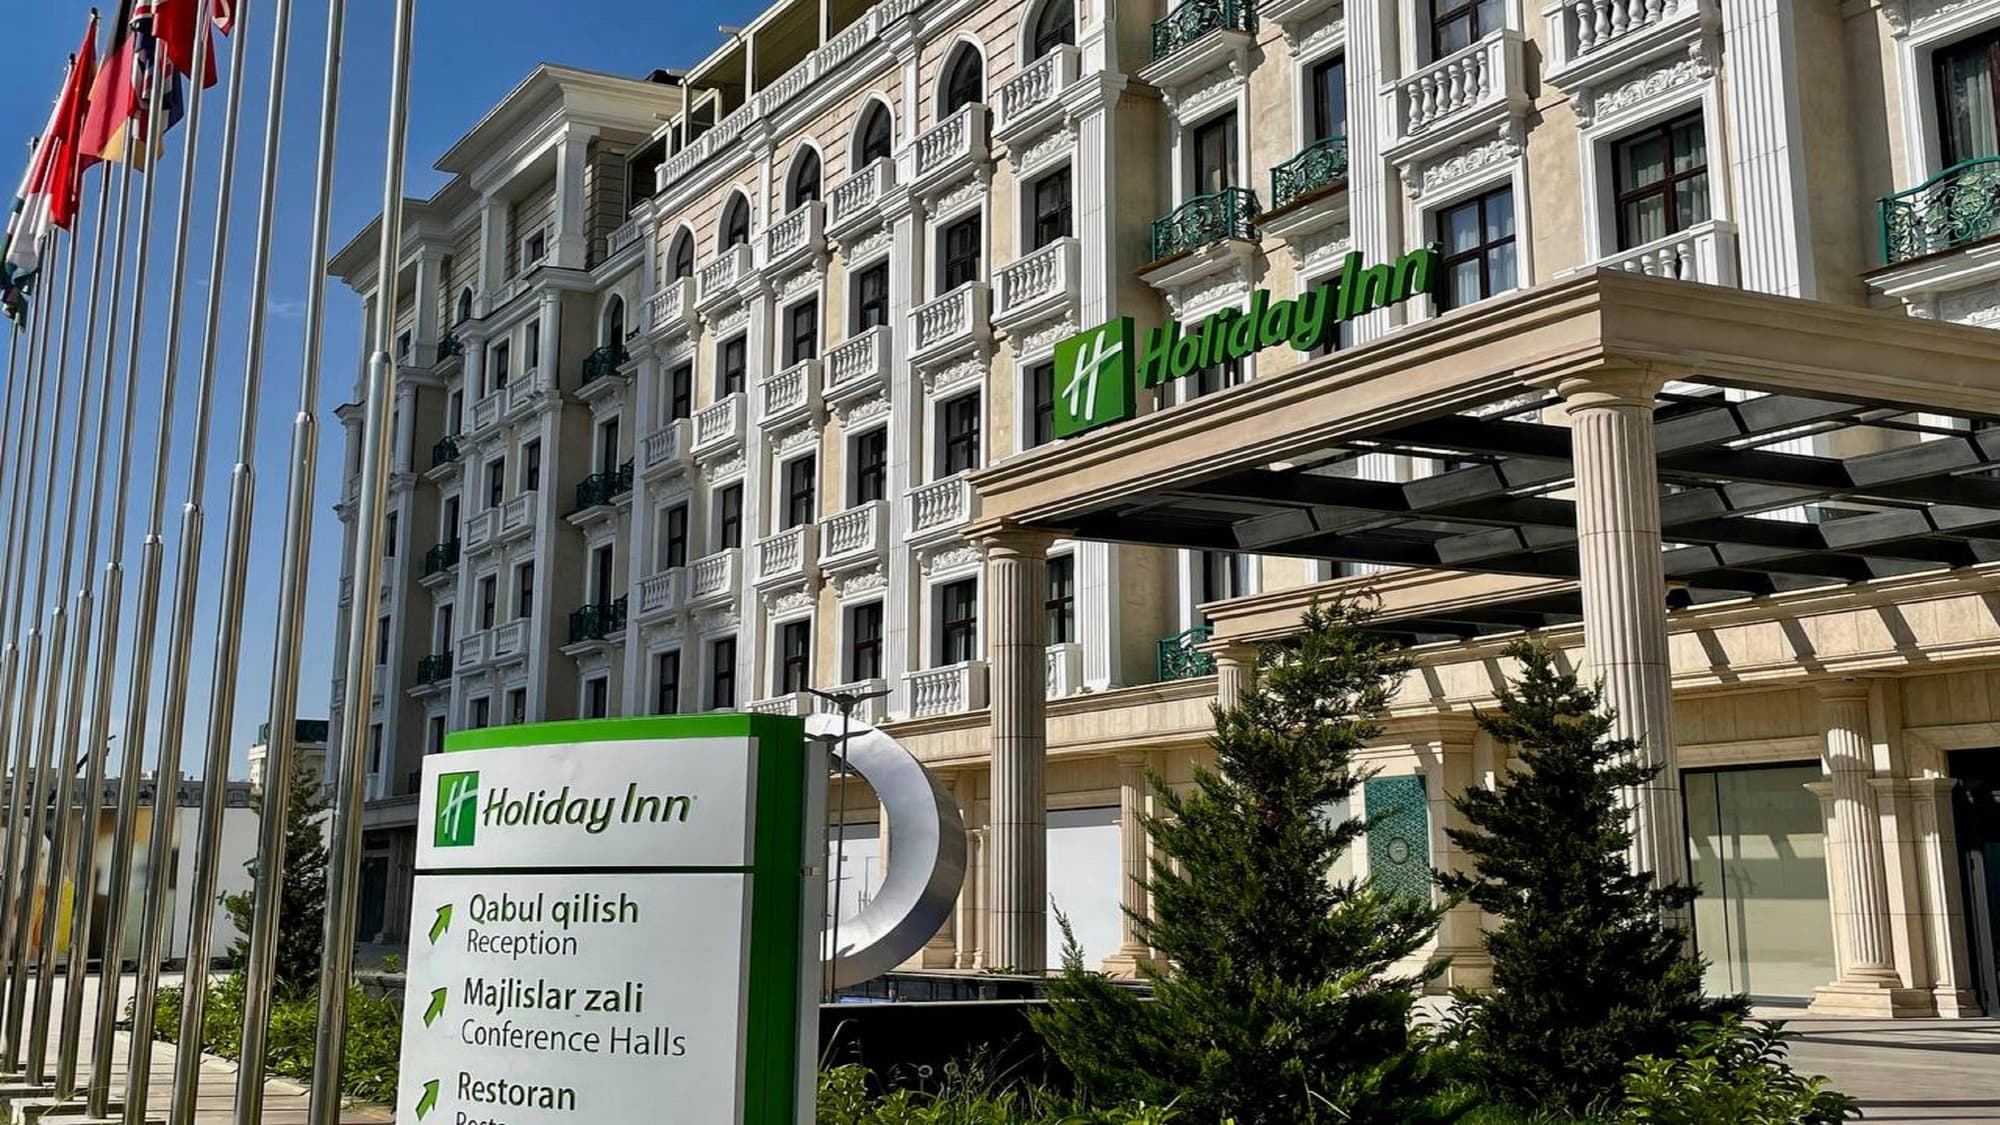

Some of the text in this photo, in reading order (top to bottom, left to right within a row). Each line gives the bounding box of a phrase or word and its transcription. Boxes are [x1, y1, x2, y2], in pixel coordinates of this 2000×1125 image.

[1137, 286, 1336, 388] Holiday
[1338, 248, 1441, 321] Inn
[483, 786, 616, 833] Holiday
[621, 783, 690, 823] Inn
[469, 893, 639, 930] Qabul qilish
[466, 929, 578, 960] Reception
[463, 977, 644, 1015] Majlislar zali
[461, 1019, 686, 1057] Conference Halls
[457, 1072, 576, 1111] Restoran
